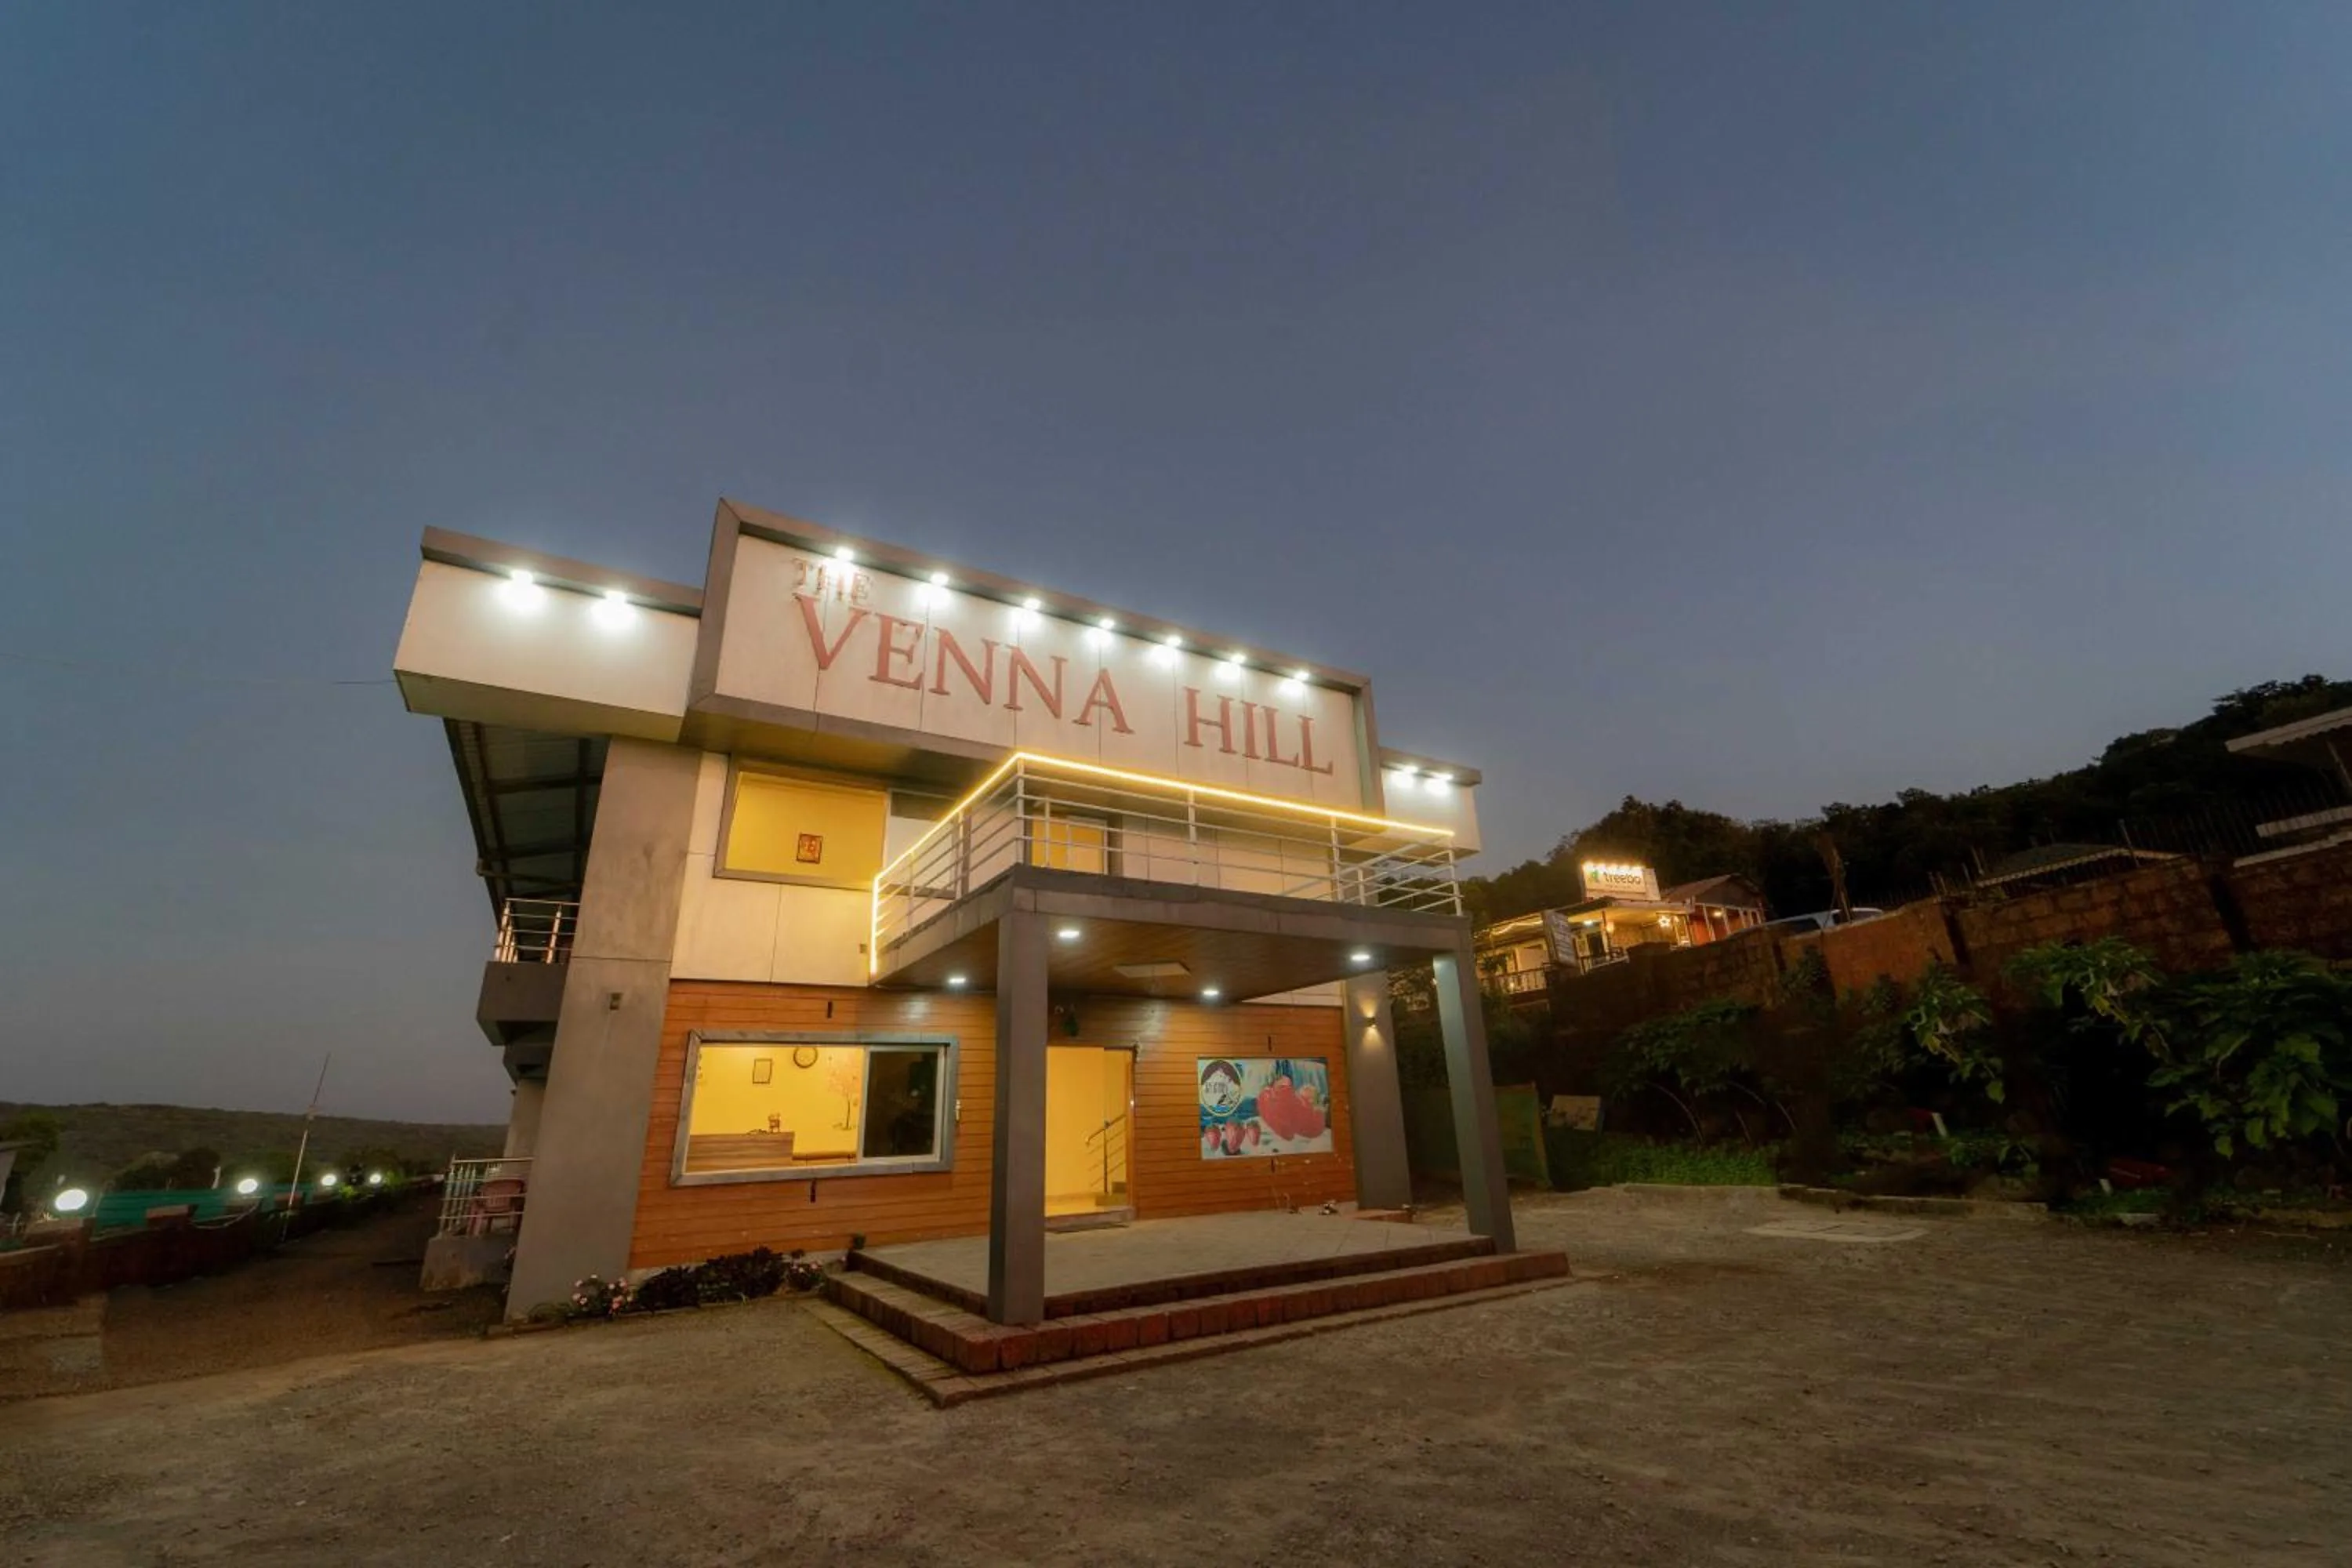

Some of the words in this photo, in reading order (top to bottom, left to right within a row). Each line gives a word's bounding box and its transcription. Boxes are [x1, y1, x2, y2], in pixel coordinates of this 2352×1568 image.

[790, 557, 873, 607] THE
[792, 592, 1134, 735] VENNA
[1182, 686, 1334, 775] HILL
